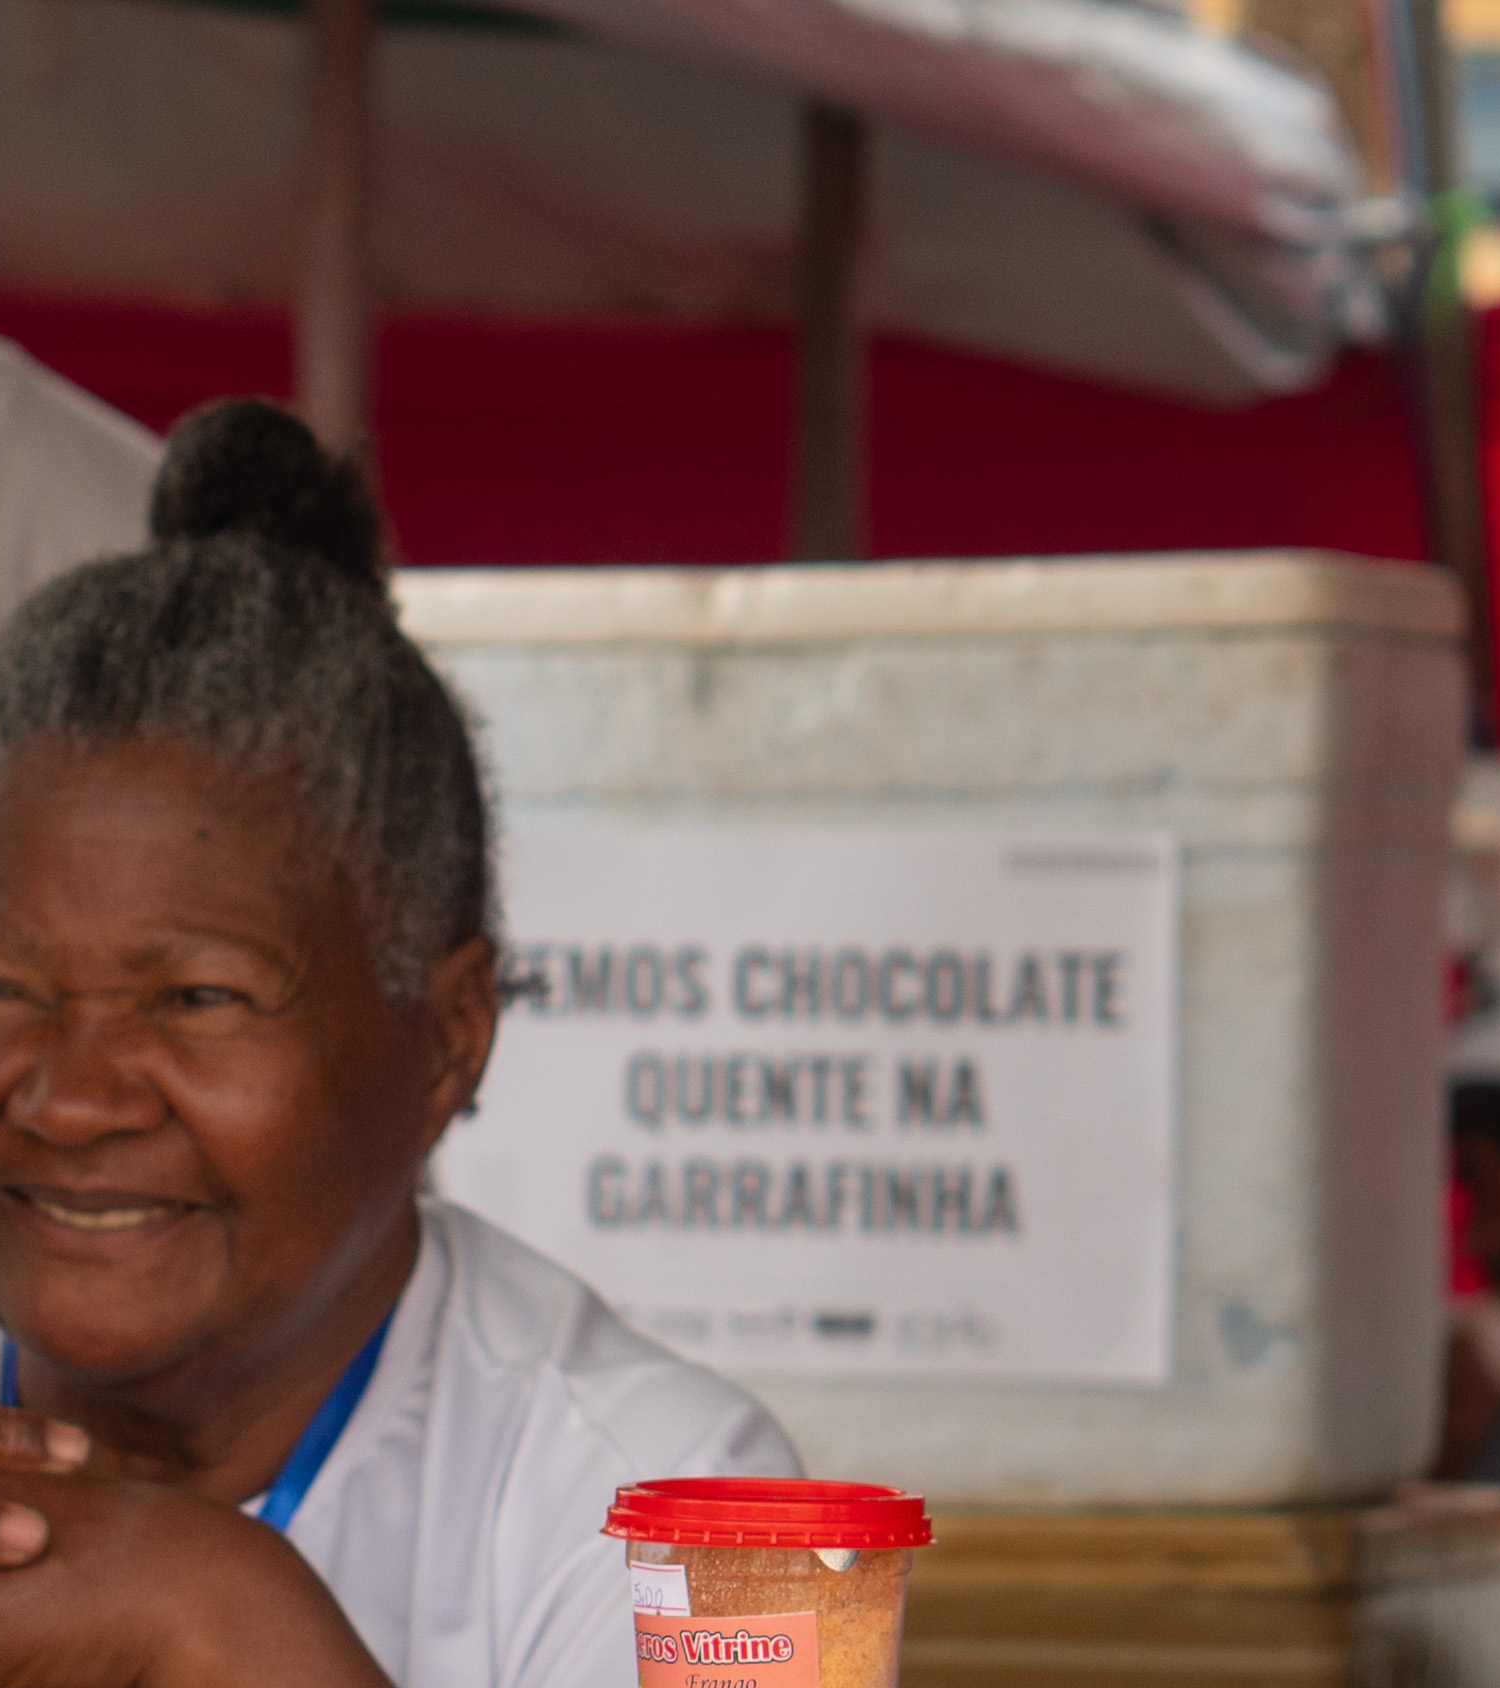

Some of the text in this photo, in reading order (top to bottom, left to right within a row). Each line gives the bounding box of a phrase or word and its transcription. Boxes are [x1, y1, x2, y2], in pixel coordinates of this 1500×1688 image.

[732, 945, 1126, 1028] CHOCOLATE
[626, 1052, 985, 1133] QUENTE NA
[586, 1158, 1022, 1239] GARRAFINHA
[680, 1629, 793, 1665] Vitrine
